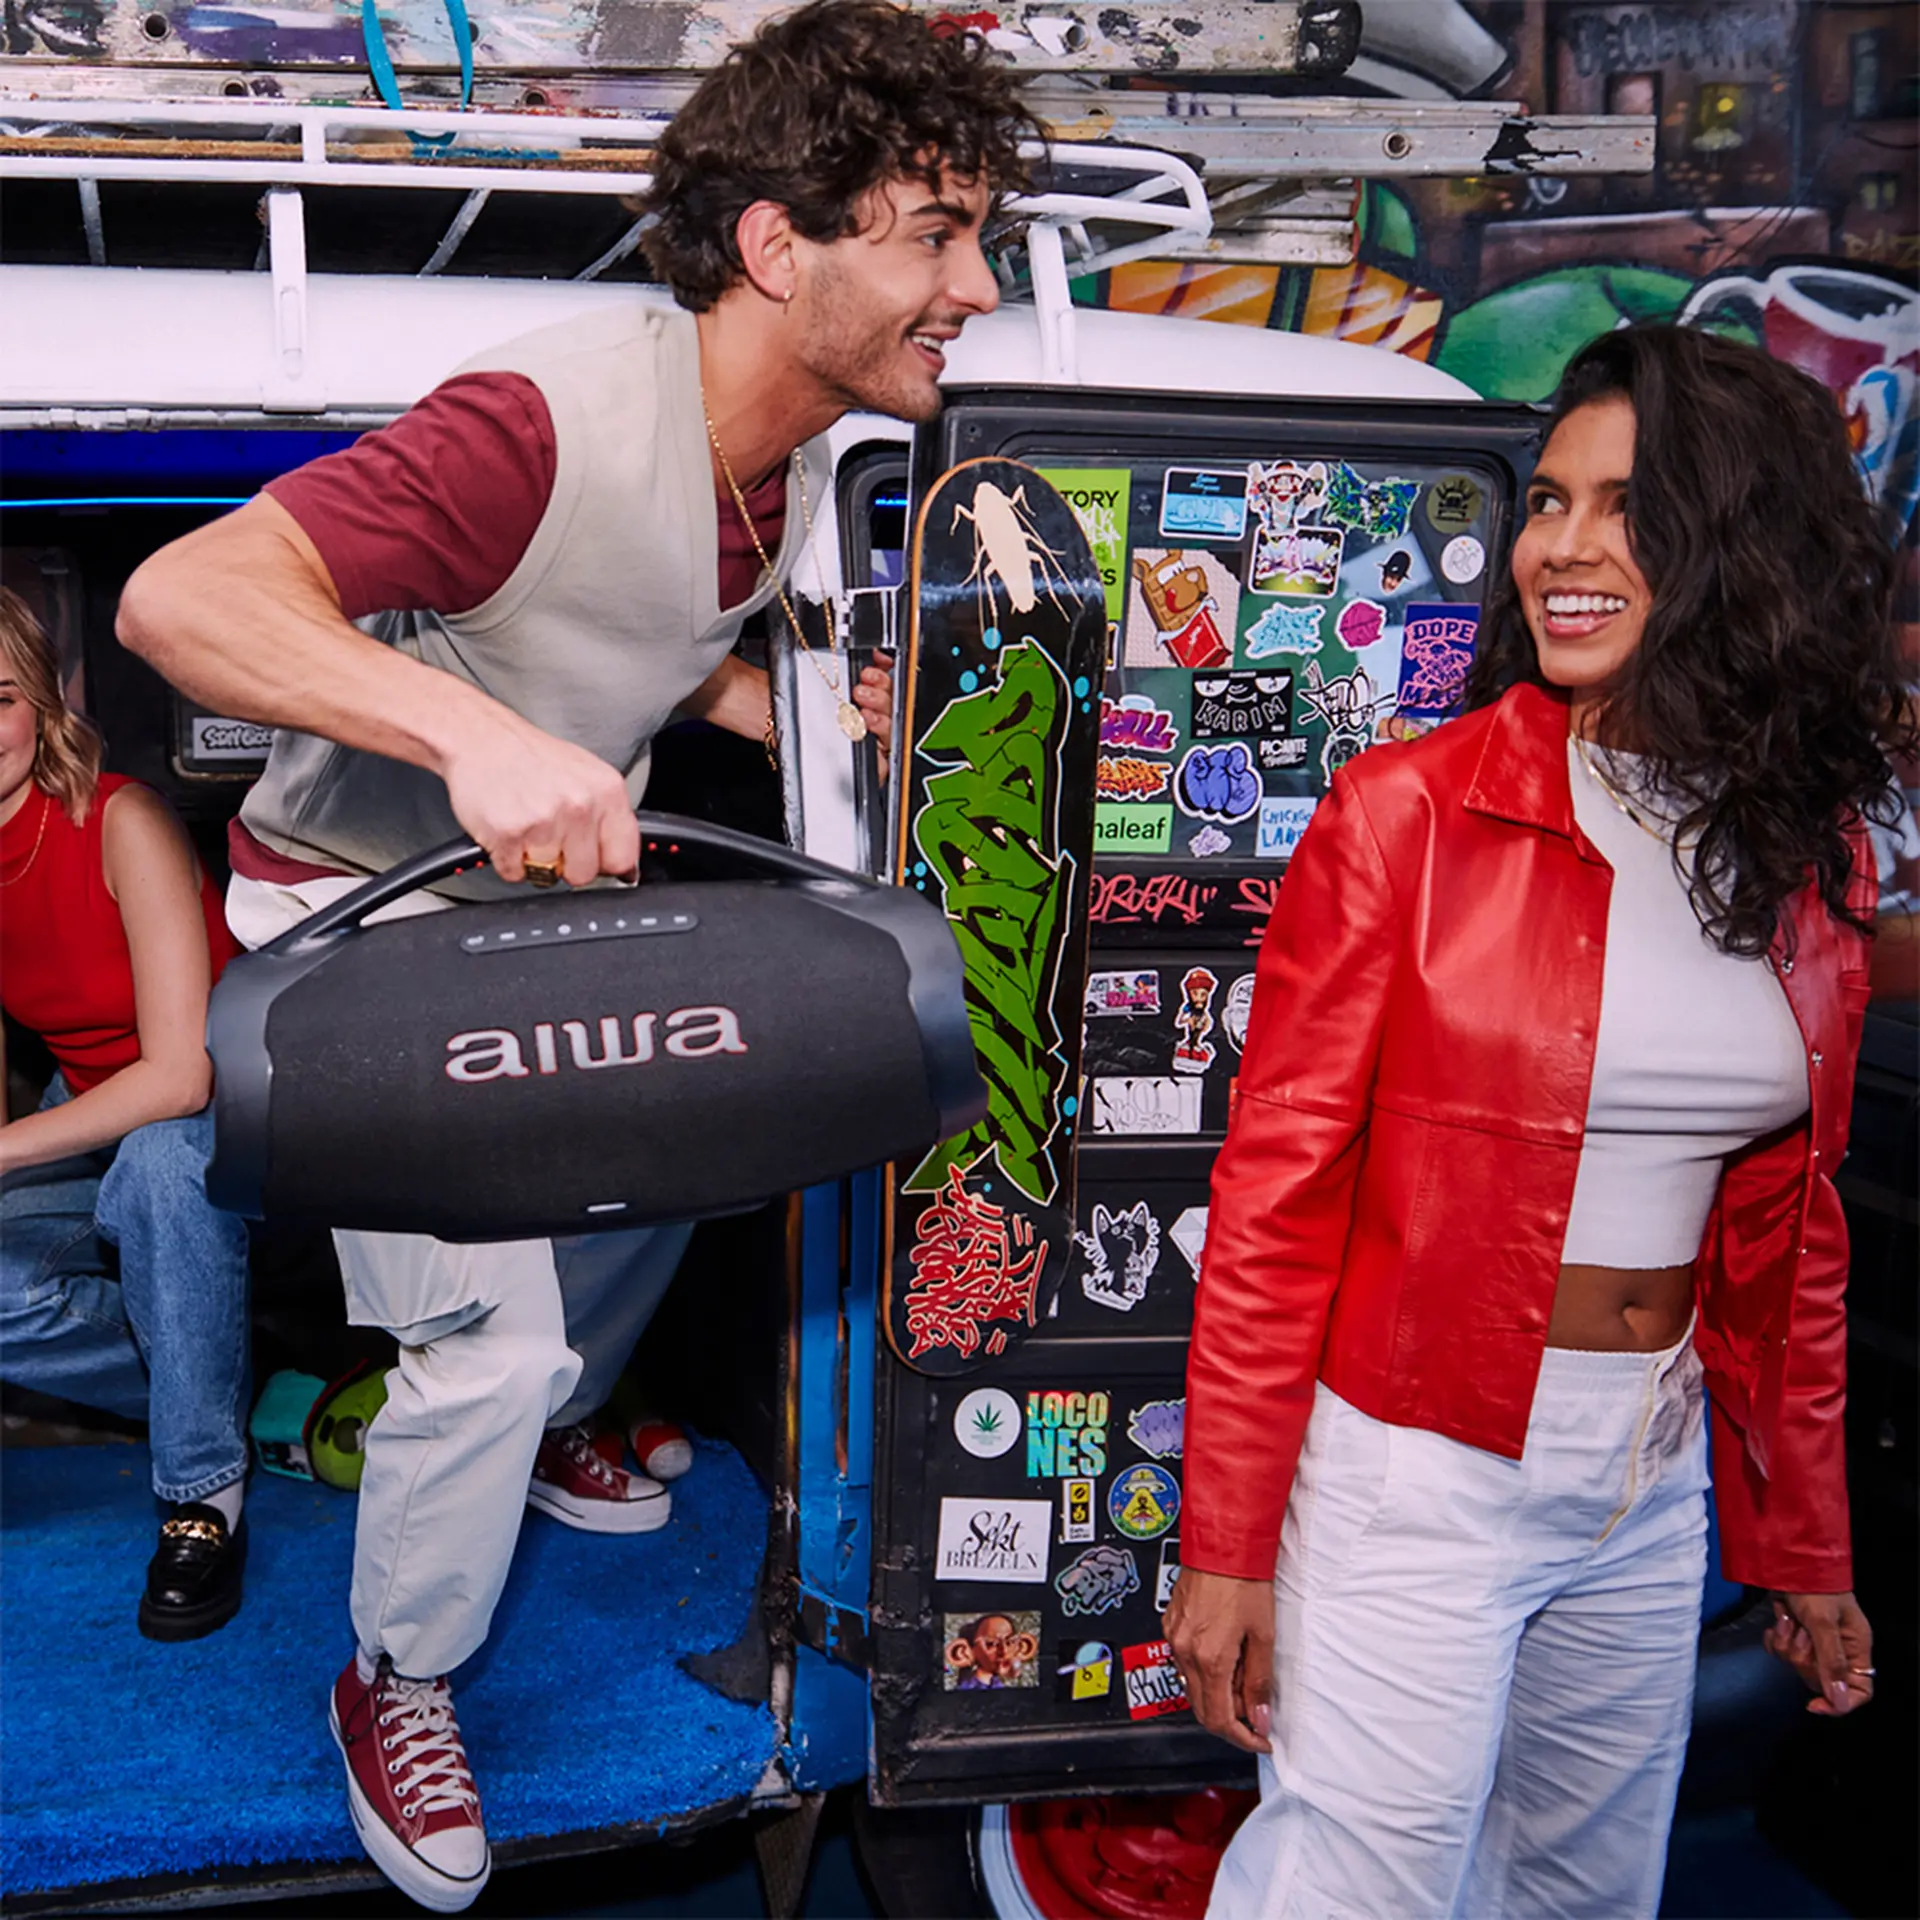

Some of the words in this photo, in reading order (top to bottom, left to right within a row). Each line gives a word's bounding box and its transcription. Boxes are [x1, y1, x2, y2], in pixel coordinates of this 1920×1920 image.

[1408, 619, 1477, 643] DOPE
[1195, 695, 1288, 732] KARIM
[444, 1004, 749, 1083] aiwa
[1026, 1391, 1109, 1428] LOCO
[1026, 1427, 1107, 1478] NES
